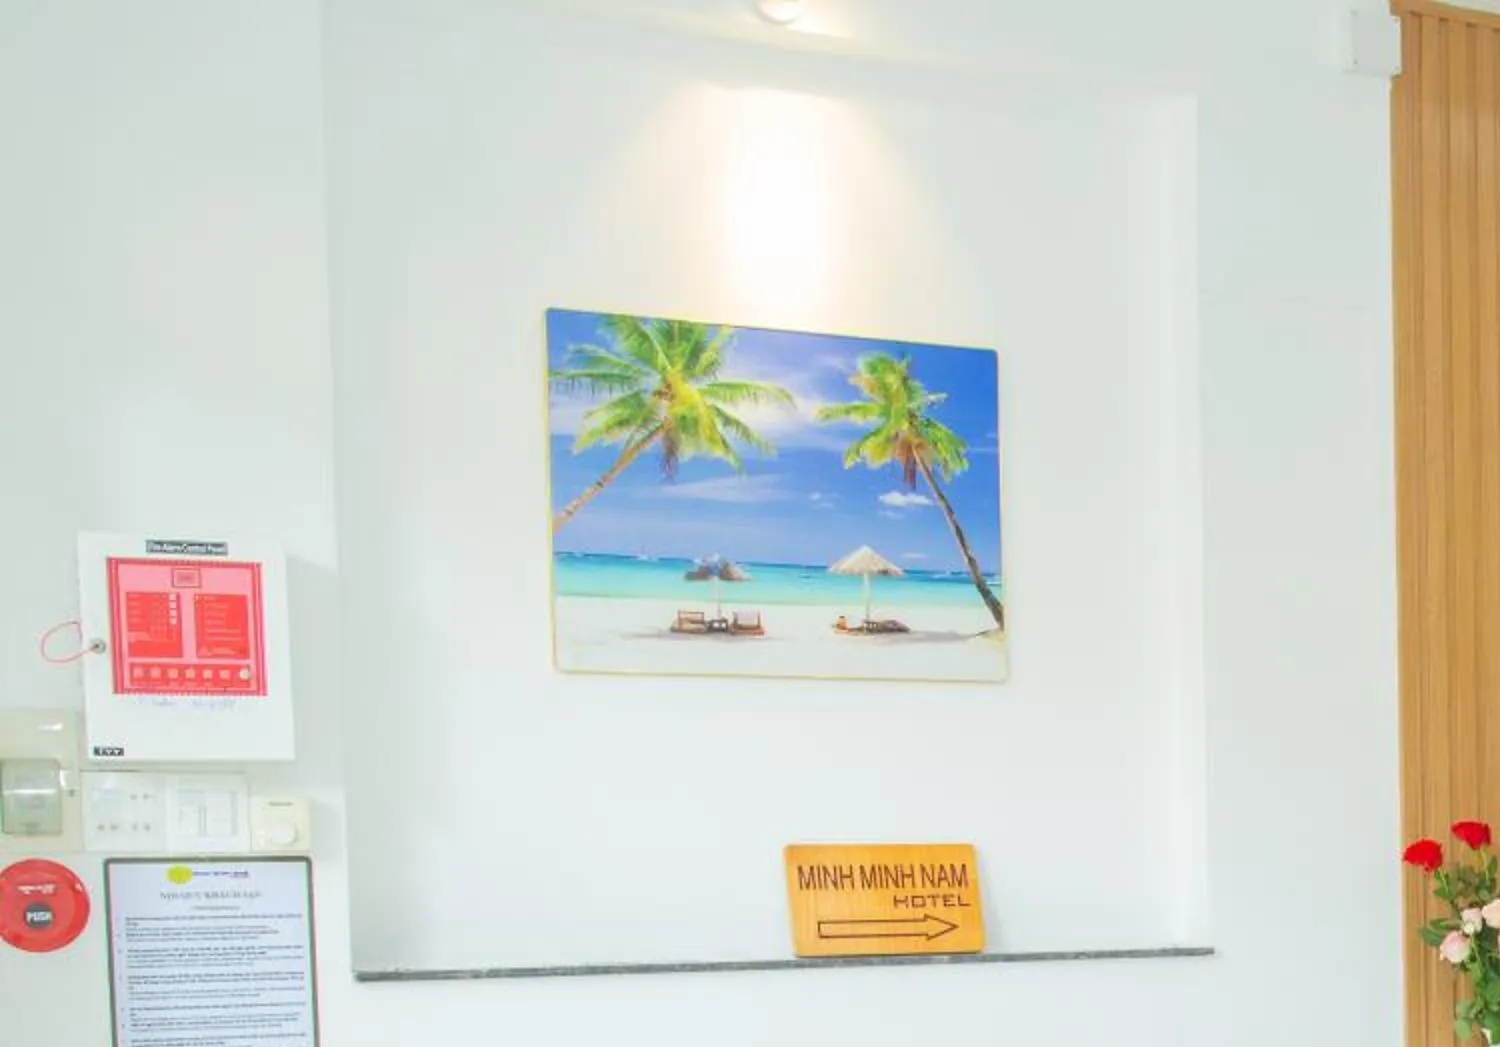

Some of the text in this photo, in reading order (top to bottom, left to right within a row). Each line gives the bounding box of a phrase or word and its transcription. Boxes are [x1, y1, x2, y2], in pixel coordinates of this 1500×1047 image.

[797, 863, 969, 891] MINH MINH NAM
[894, 893, 970, 909] HOTEL
